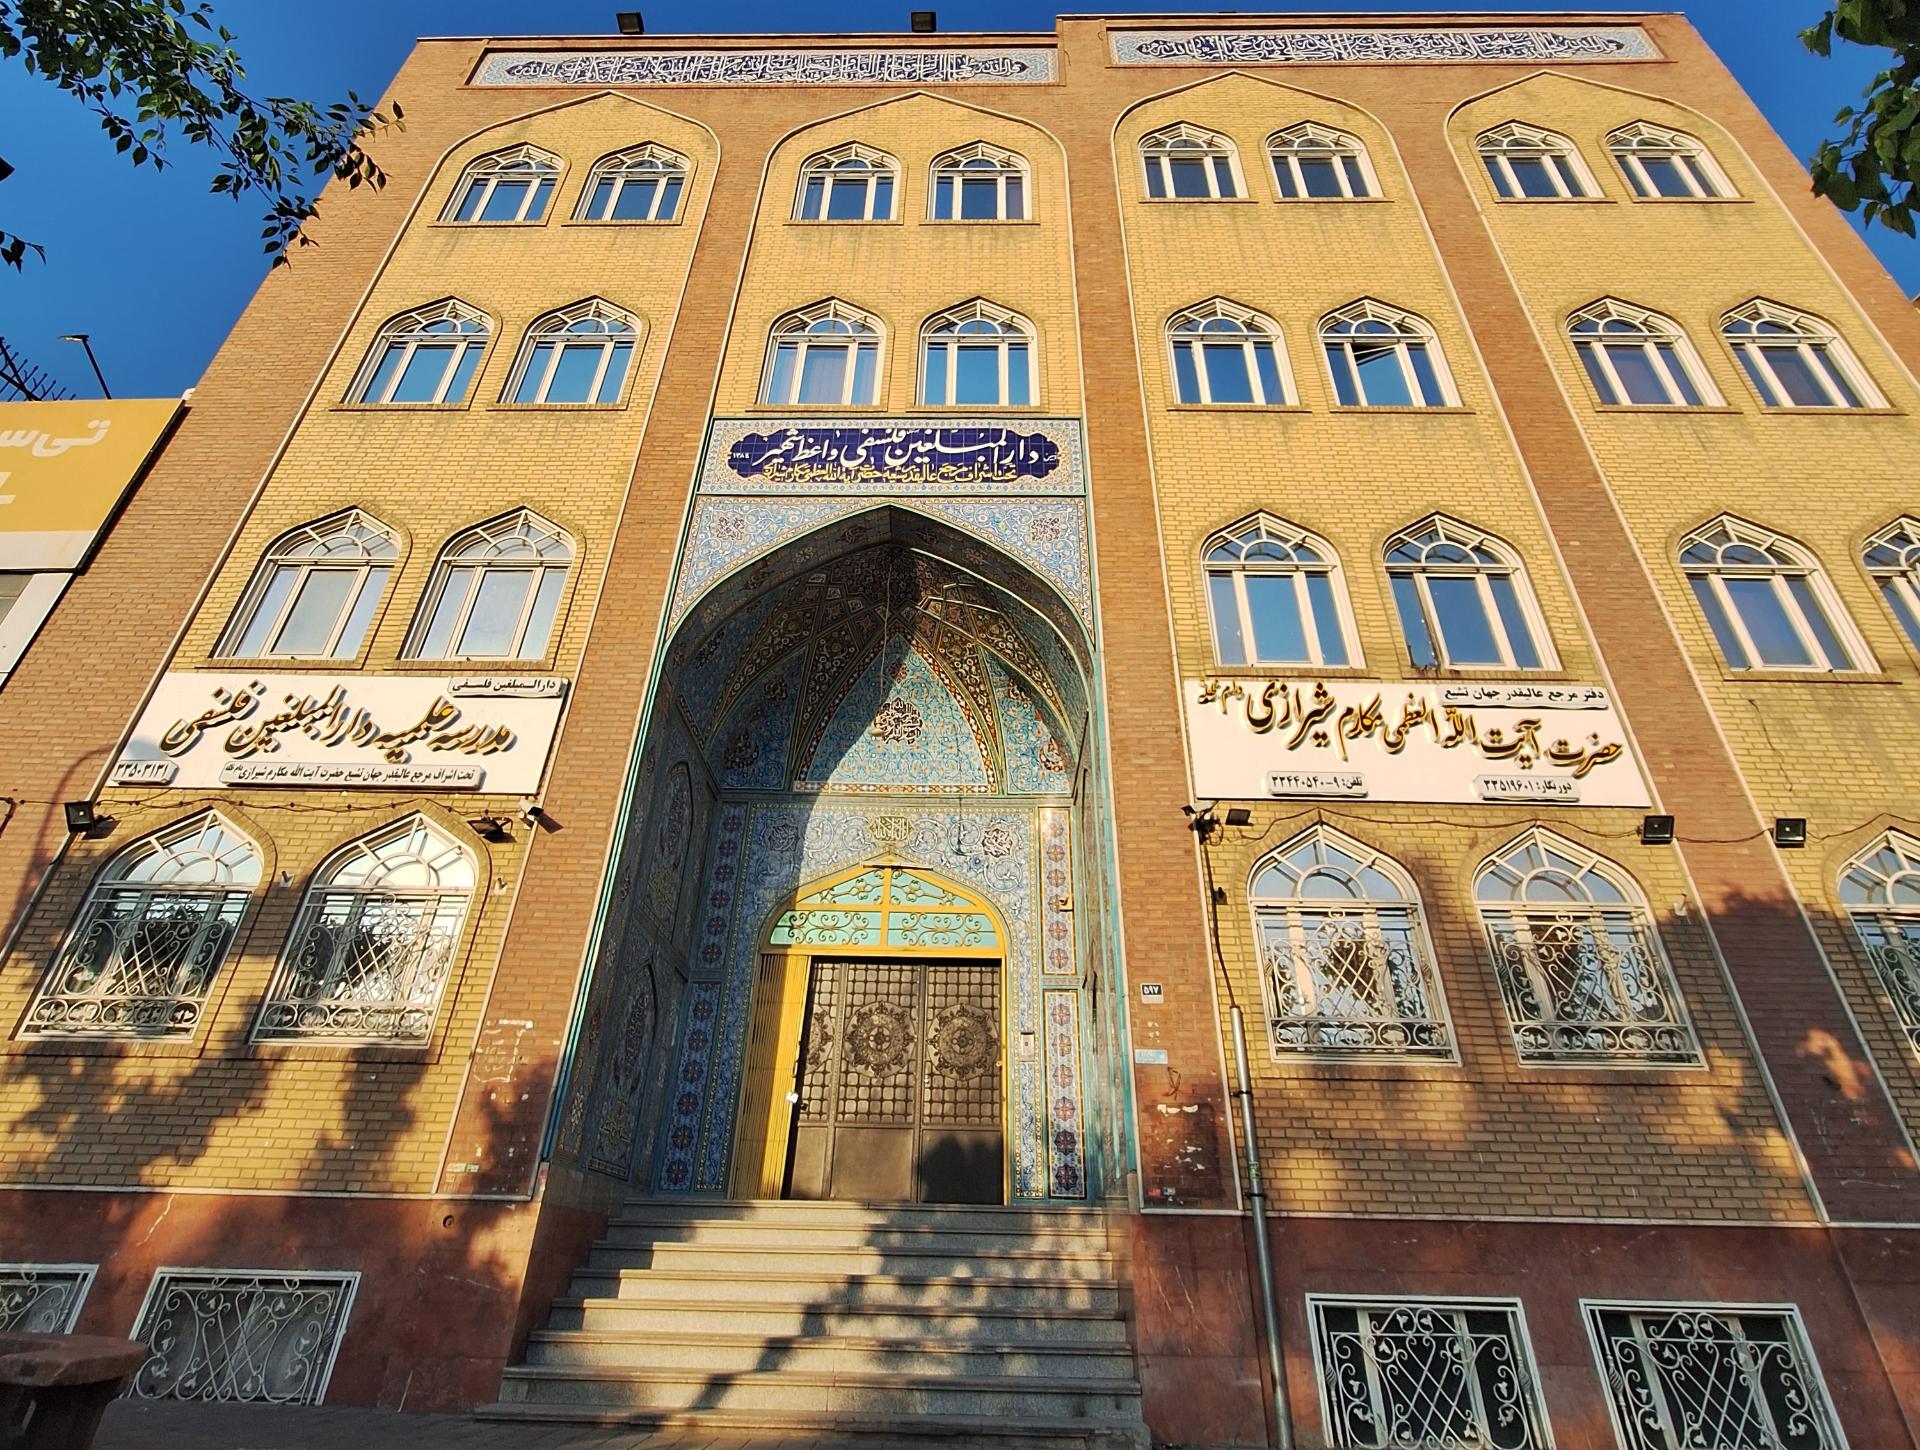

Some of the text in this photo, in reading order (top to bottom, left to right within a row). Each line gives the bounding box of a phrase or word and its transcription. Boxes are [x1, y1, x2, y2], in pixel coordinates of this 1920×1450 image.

[752, 428, 805, 467] شهیر
[792, 437, 838, 462] واعظ
[840, 428, 905, 468] فلسفی
[784, 463, 811, 482] مکارم
[797, 463, 833, 482] العظمی
[852, 464, 882, 482] حضرت
[902, 463, 938, 482] عالیقدر
[937, 463, 968, 483] مرجع
[452, 678, 492, 692] فلسفی
[1444, 687, 1605, 702] دفتر مرجع عالیقدر جهان تشیع
[1221, 681, 1244, 714] دام
[159, 679, 267, 758] فلسفی
[1246, 680, 1337, 751] شیرازی
[1384, 692, 1439, 754] العظمی
[373, 695, 462, 764] علمیه
[1338, 693, 1385, 762] مکارم
[1442, 708, 1478, 748] الله
[427, 724, 517, 756] مدرسه
[1480, 718, 1541, 769] آیت
[1547, 732, 1623, 778] حضرت
[238, 766, 267, 780] شیرازی
[266, 766, 288, 780] مکارم
[290, 763, 303, 777] الله
[303, 765, 321, 780] آیت
[320, 767, 344, 781] حضرت
[344, 768, 364, 781] تشیع
[363, 767, 382, 781] جهان
[383, 768, 410, 783] عالیقدر
[410, 770, 432, 783] مرجع
[433, 768, 457, 783] اشراف
[456, 769, 476, 781] تحت
[1342, 776, 1363, 789] تلفن:
[1484, 780, 1572, 794] دورنگار: ۳۳۵۱۹۶۰۱
